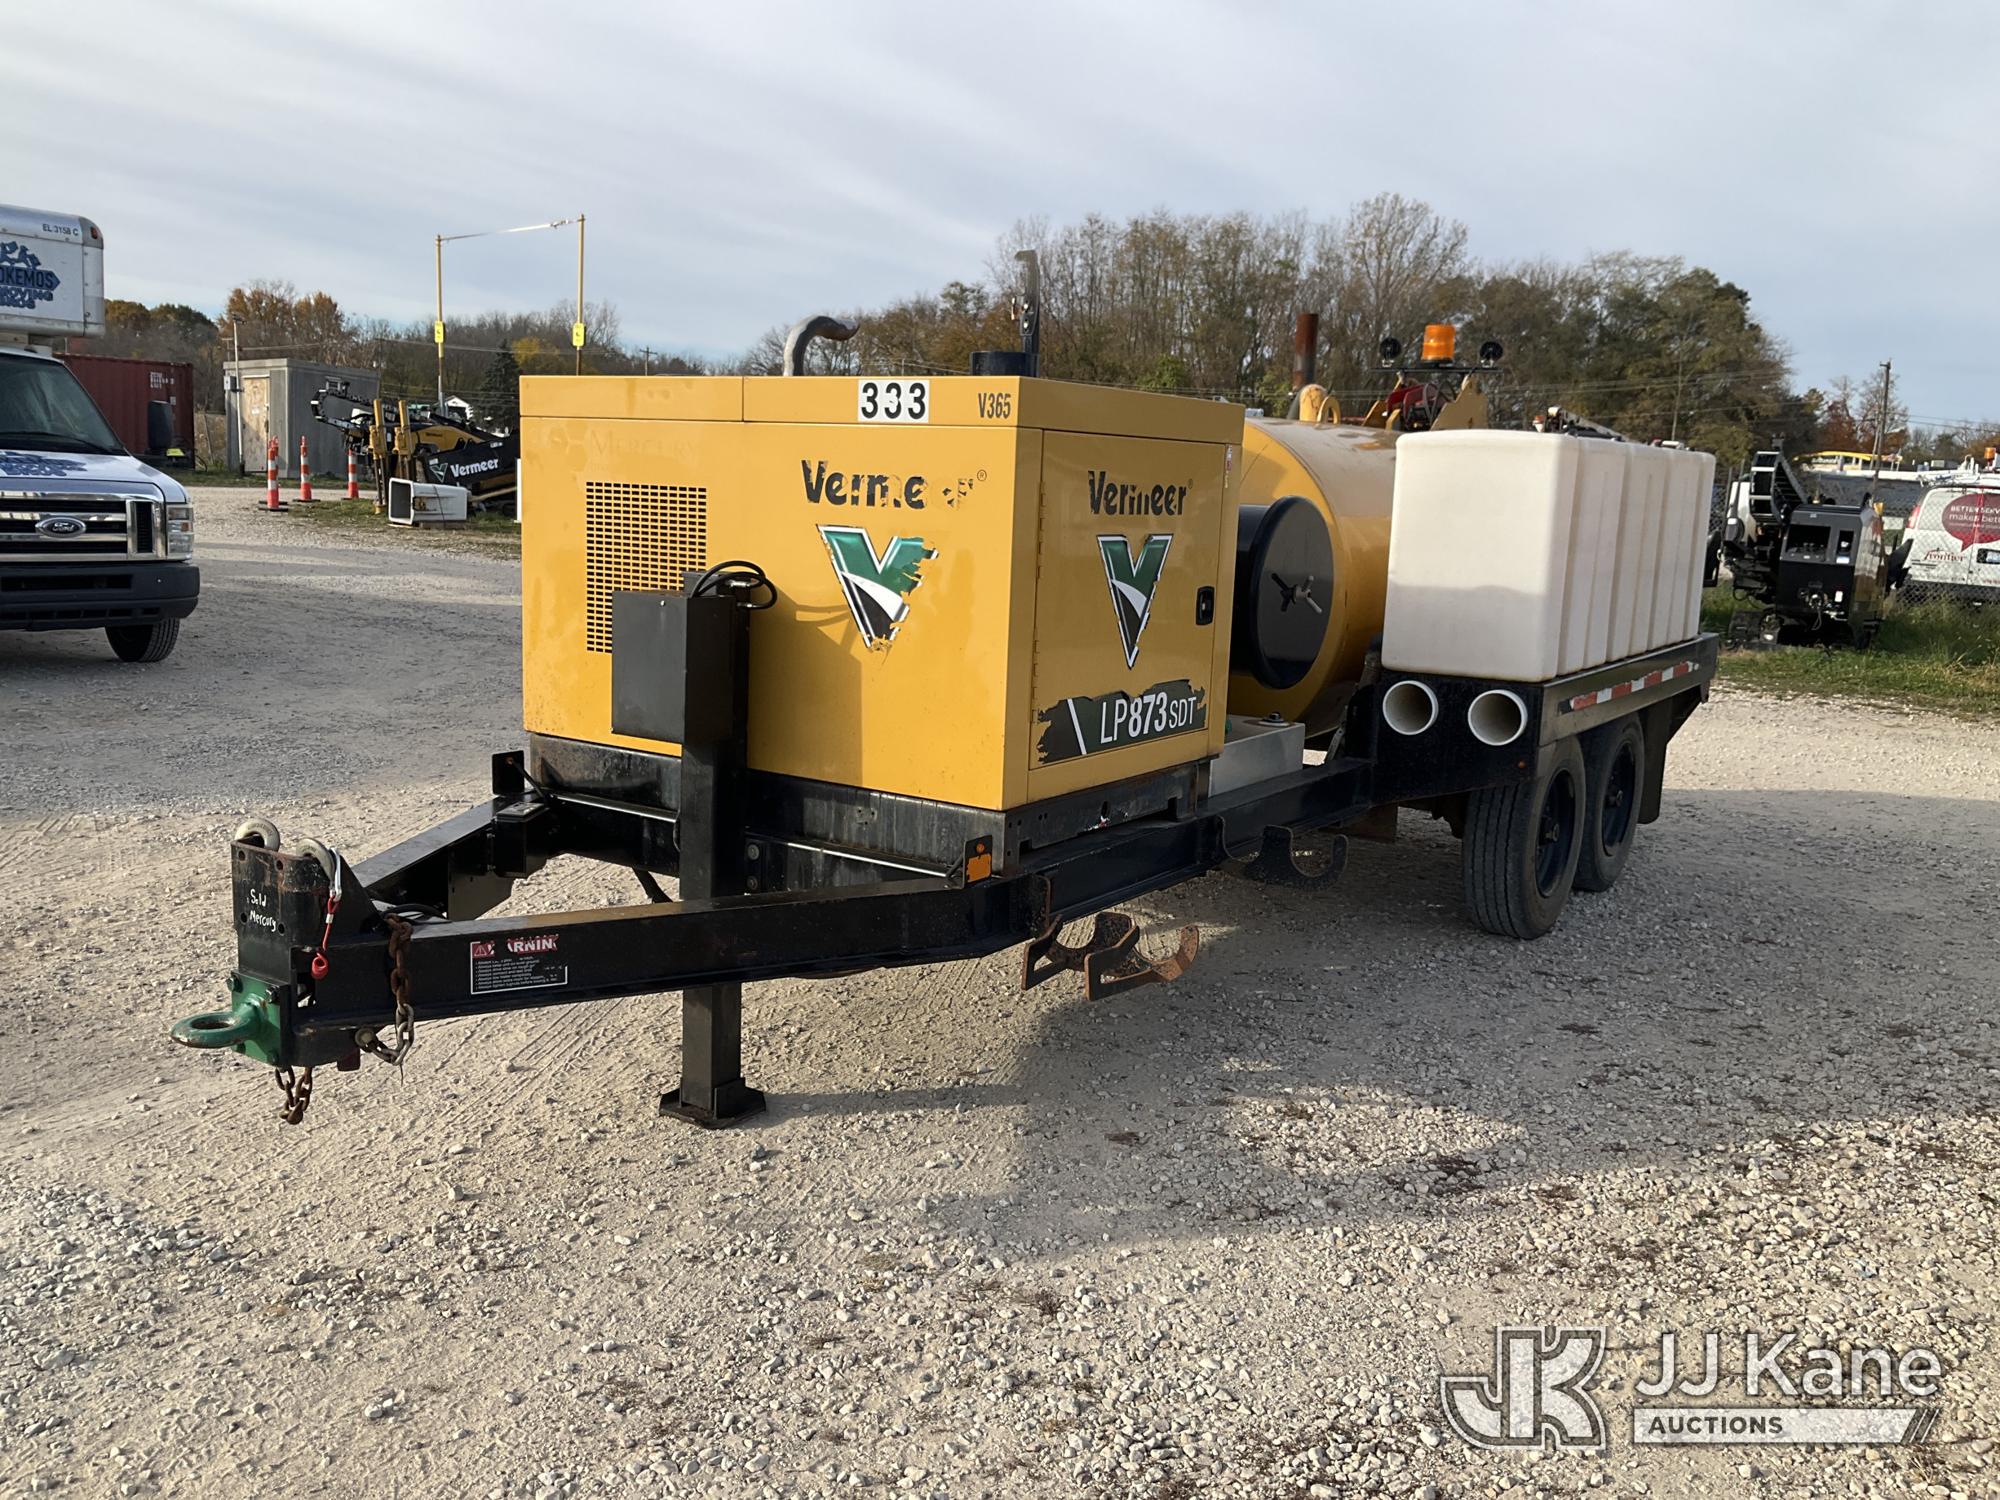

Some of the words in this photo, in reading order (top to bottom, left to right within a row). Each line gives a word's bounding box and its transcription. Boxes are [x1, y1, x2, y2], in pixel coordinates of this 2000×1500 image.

[861, 382, 926, 419] 333
[978, 392, 1012, 419] V365
[450, 458, 499, 478] Vermeer
[1088, 470, 1187, 516] Vermeer
